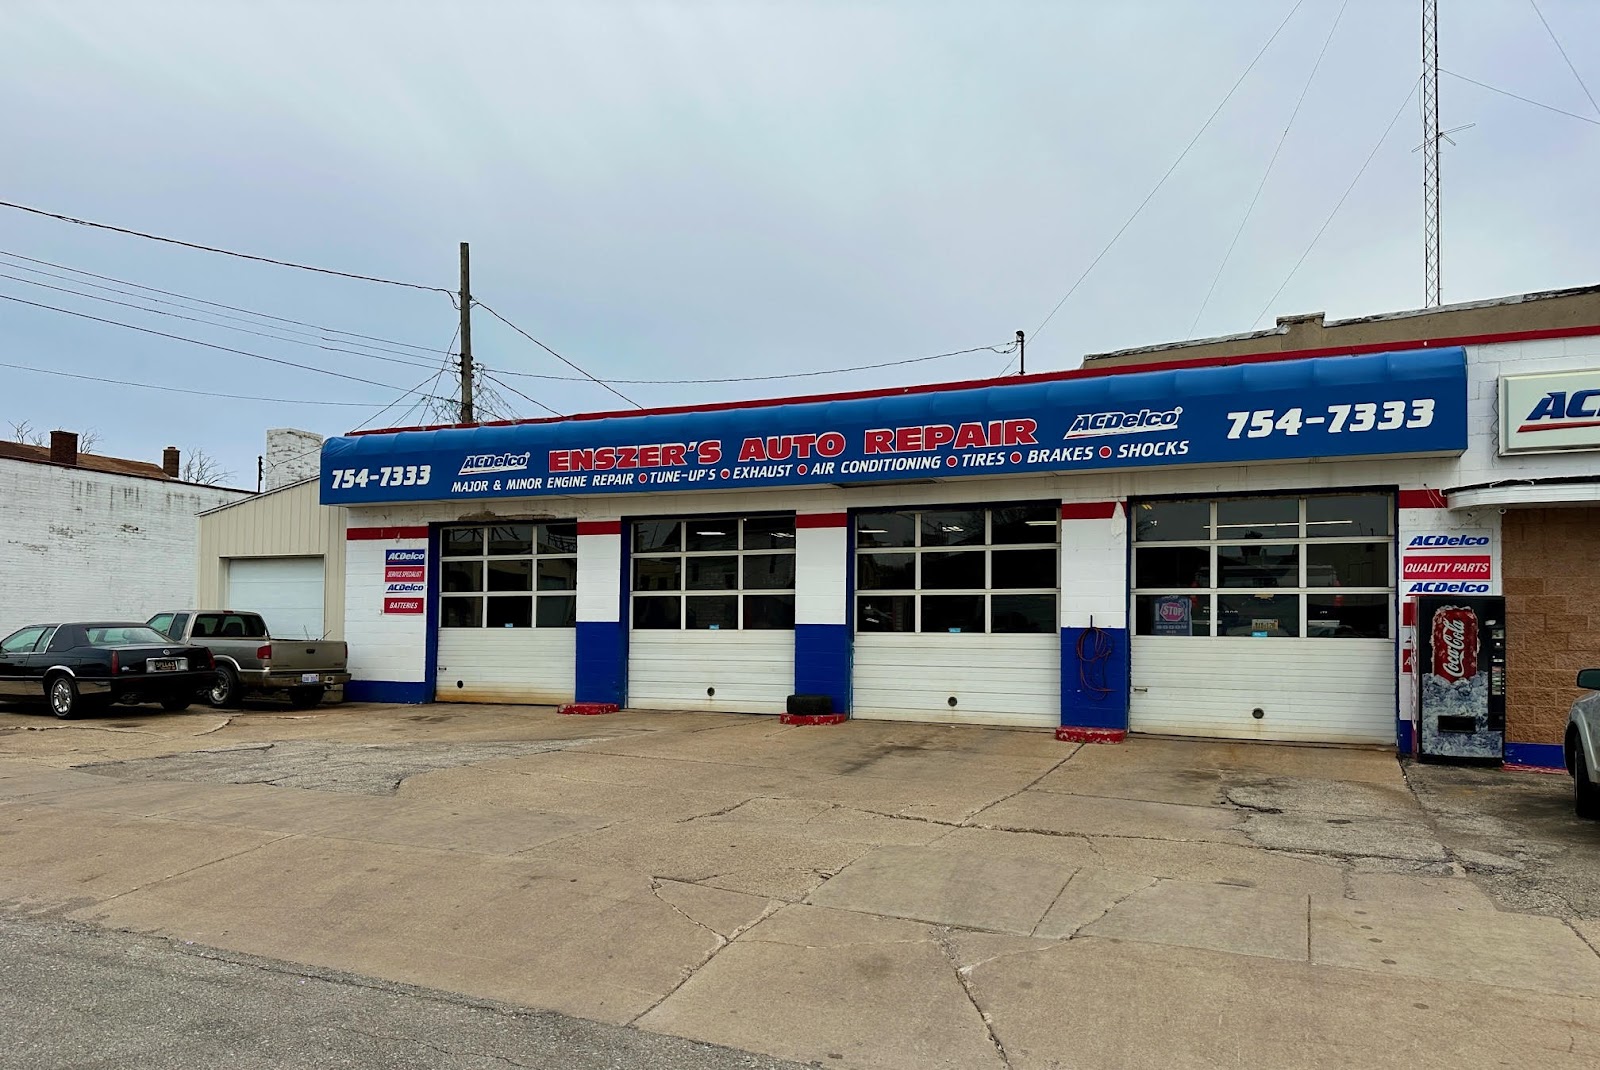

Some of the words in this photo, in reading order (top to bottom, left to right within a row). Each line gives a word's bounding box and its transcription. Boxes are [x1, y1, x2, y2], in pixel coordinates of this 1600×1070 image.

[1525, 388, 1600, 421] AC
[1069, 408, 1179, 433] ACDelco
[1226, 398, 1436, 440] 754-7333
[549, 440, 722, 473] ENSZER'S
[738, 431, 846, 463] AUTO
[864, 417, 1039, 455] REPAIR
[451, 480, 488, 493] MAJOR
[493, 479, 502, 491] &
[506, 477, 542, 491] MINOR
[547, 475, 588, 489] ENGINE
[592, 473, 634, 487] REPAIR
[649, 468, 716, 484] TUNE-UP'S
[732, 463, 793, 480] EXHAUST
[811, 462, 835, 476] AIR
[840, 455, 942, 474] CONDITIONING
[962, 451, 1005, 467] TIRES
[1027, 446, 1094, 463] BRAKES
[1117, 440, 1190, 458] SHOCKS
[462, 453, 529, 472] ACDelco
[331, 464, 432, 489] 754-7333
[1408, 534, 1490, 547] ACDelco
[388, 552, 425, 561] ACDelco
[1404, 562, 1452, 573] QUALITY
[1452, 562, 1489, 573] PARTS
[387, 583, 424, 591] ACDelco
[1409, 581, 1490, 593] ACDelco
[389, 601, 419, 609] BATTERIES
[1162, 605, 1182, 617] STOP
